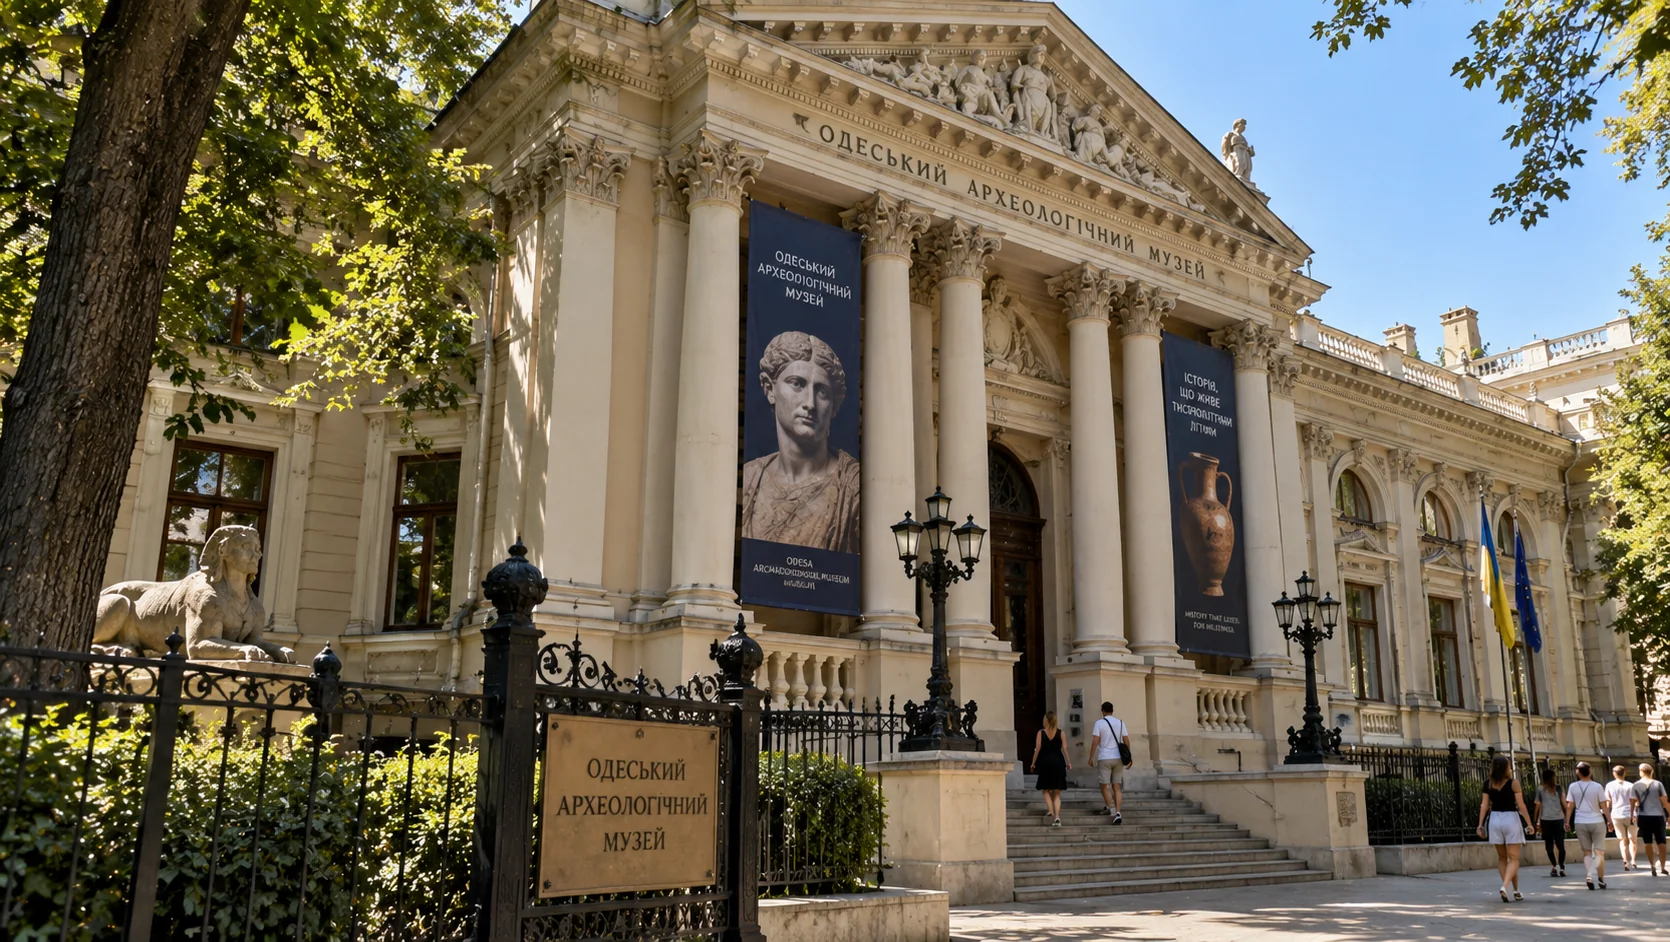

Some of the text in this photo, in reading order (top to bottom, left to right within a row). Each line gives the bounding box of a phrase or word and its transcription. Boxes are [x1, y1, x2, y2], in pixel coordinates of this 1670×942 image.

[819, 124, 1206, 280] ОДЕСЬКИЙ АРХЕОЛОГІЧНИЙ МУЗЕЙ
[775, 250, 836, 279] ОДЕСЬКИЙ
[786, 556, 813, 569] ODESA
[587, 758, 686, 782] ОДЕСЬКИЙ
[556, 793, 708, 816] АРХЕОЛОГІЧНИЙ
[603, 827, 665, 852] МУЗЕЙ
